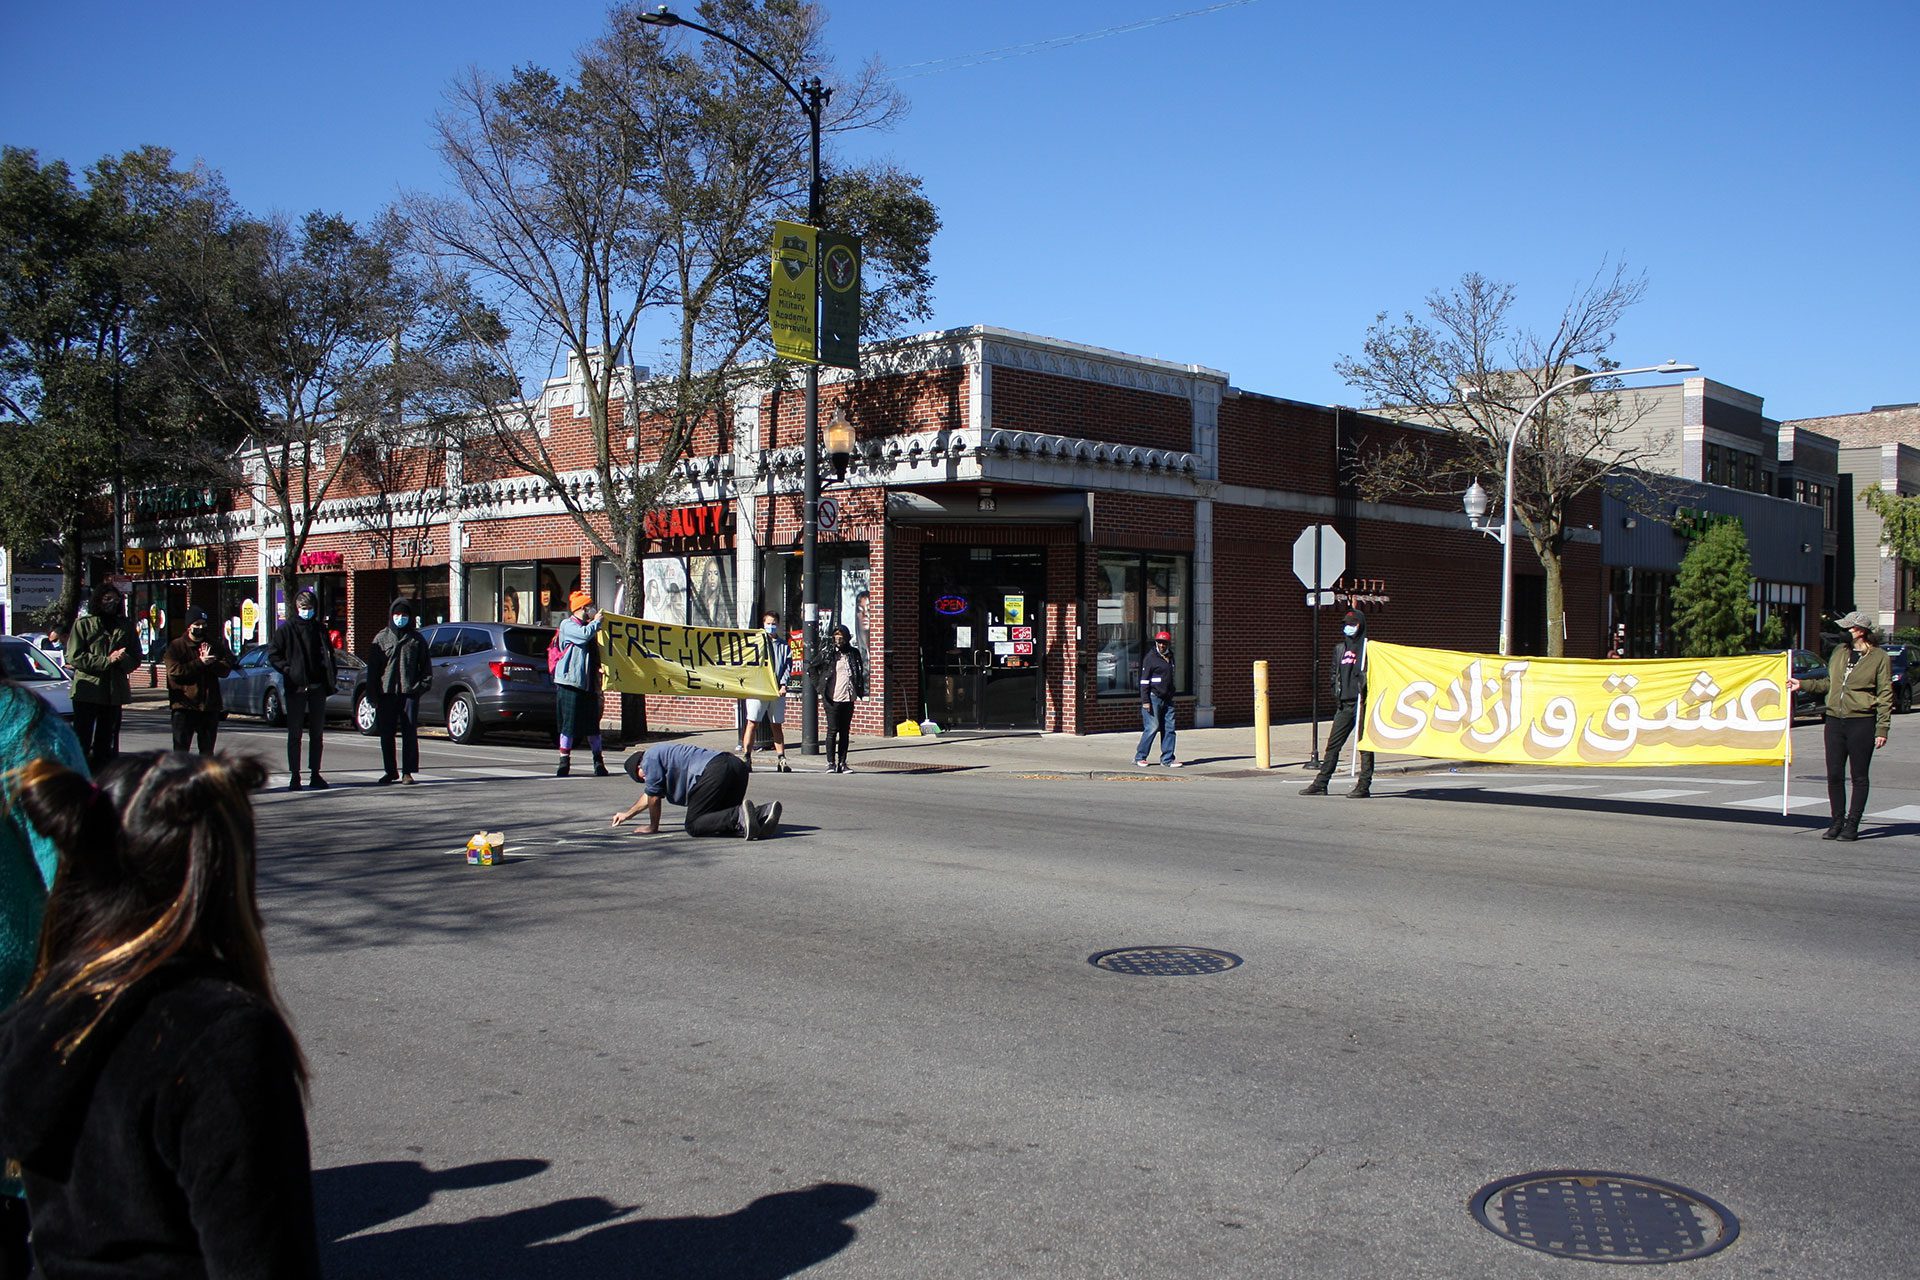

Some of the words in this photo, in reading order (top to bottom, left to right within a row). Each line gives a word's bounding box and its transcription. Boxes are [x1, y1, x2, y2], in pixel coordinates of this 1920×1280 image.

[778, 288, 806, 301] Chicago
[778, 299, 805, 313] Military
[773, 320, 812, 334] Bronzeville
[775, 310, 808, 324] Academy
[644, 506, 723, 539] BEAUTY
[936, 599, 966, 611] OPEN
[608, 621, 673, 662] FREE
[697, 629, 769, 667] KIDS!
[1371, 659, 1530, 752] آزادی
[1578, 671, 1787, 763] عشق
[1524, 696, 1577, 759] و
